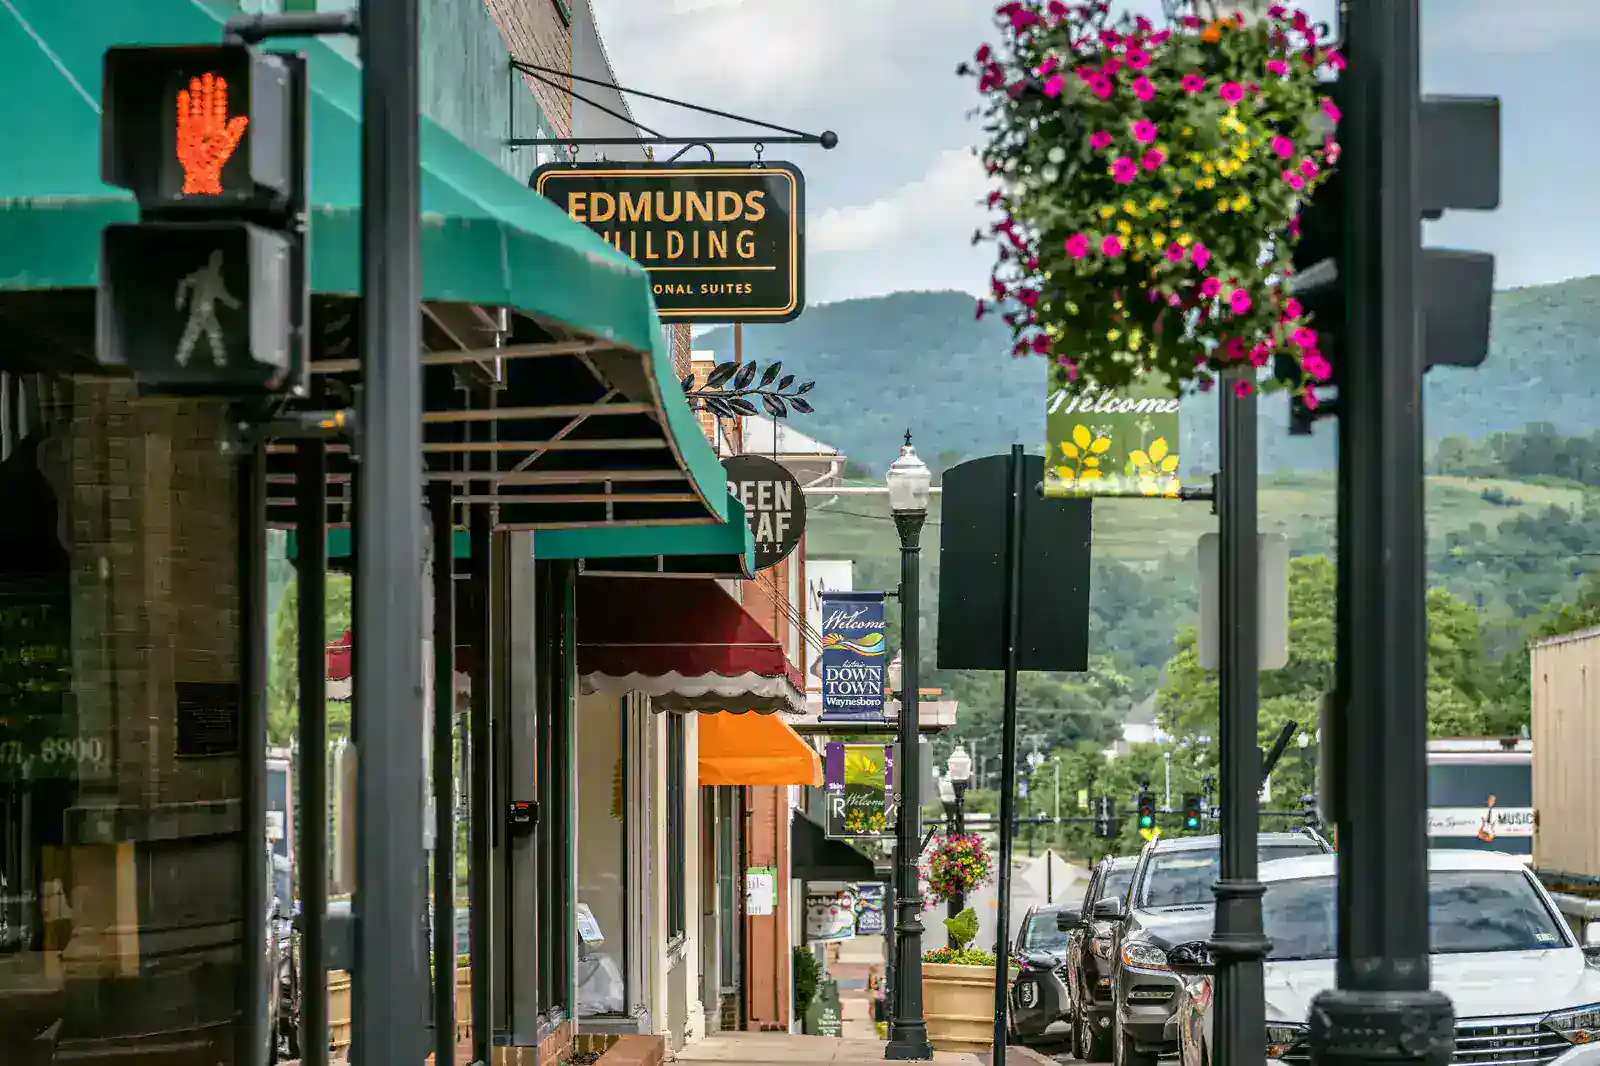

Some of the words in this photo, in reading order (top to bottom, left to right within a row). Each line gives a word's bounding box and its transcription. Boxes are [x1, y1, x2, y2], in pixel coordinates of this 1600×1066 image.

[568, 190, 765, 222] EDMUNDS
[653, 283, 694, 294] ONAL
[701, 283, 752, 294] SUITES
[822, 606, 885, 630] Welcome
[826, 668, 882, 681] DOWN
[826, 681, 882, 694] TOWN
[826, 696, 882, 707] Waynesboro
[1498, 812, 1533, 825] MUSIC
